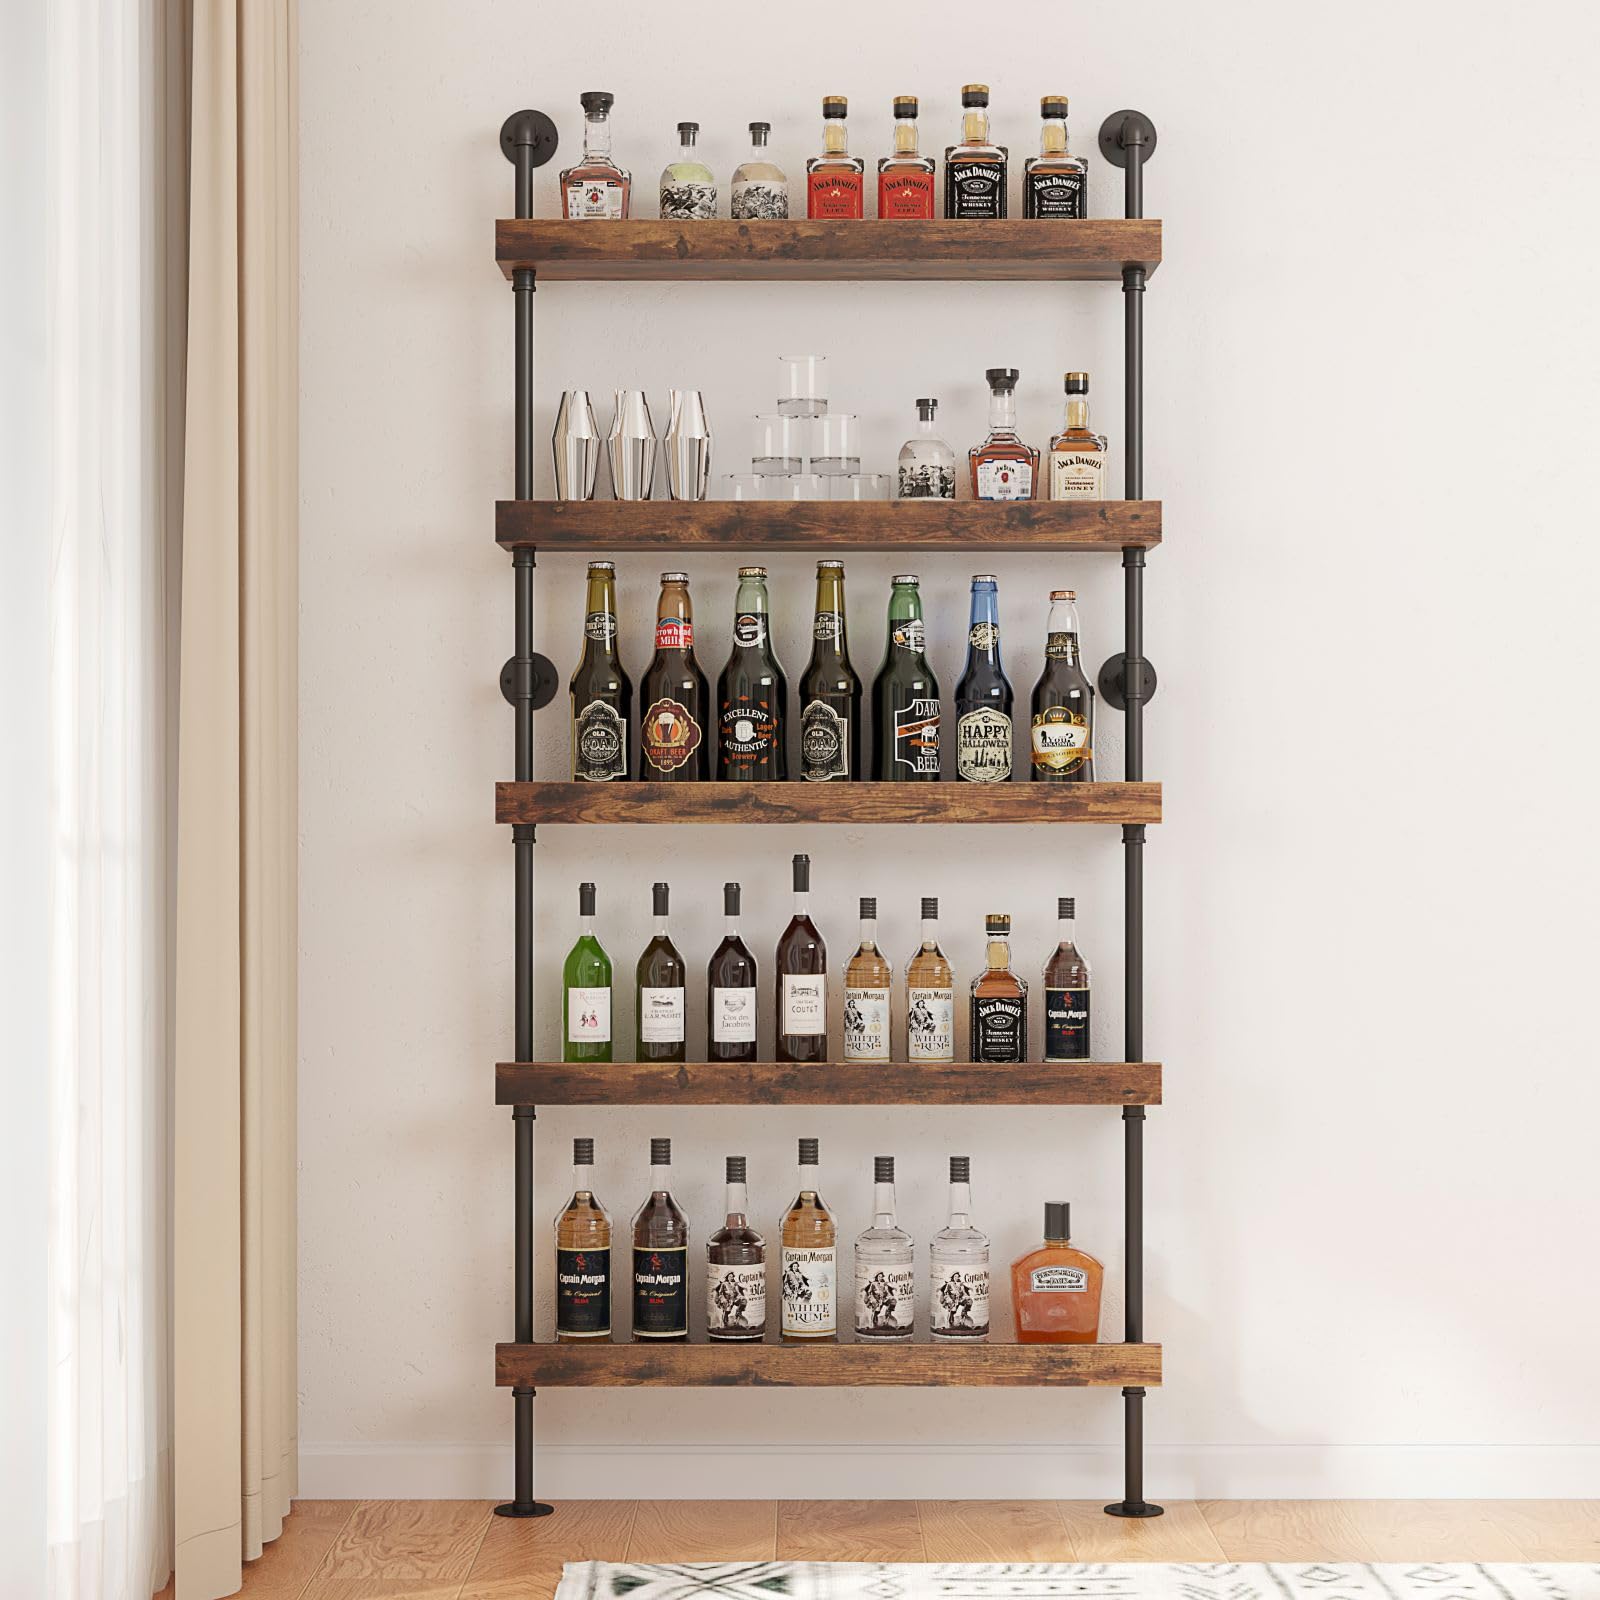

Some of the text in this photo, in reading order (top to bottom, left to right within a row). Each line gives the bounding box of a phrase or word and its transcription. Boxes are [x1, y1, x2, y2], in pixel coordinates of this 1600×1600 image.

[954, 166, 1002, 182] JACK DANIEL'S
[1034, 177, 1081, 190] JACK DANIEL'S
[1057, 458, 1075, 470] JACK
[723, 708, 769, 722] EXCELLENT
[757, 723, 773, 731] Lager
[963, 725, 1008, 738] HAPPY
[724, 738, 769, 752] AUTHENTIC
[963, 740, 1009, 748] HALLOWEEN
[650, 748, 687, 756] DRAFT BEER
[732, 753, 757, 761] Brewery
[979, 1001, 1022, 1017] JACK DANIEL'S
[851, 1043, 875, 1051] RUM
[921, 1043, 944, 1051] RUM
[785, 1251, 833, 1263] Captain Morgan
[580, 1274, 605, 1285] Morgan
[655, 1274, 681, 1286] Morgan
[795, 1312, 822, 1323] RUM
